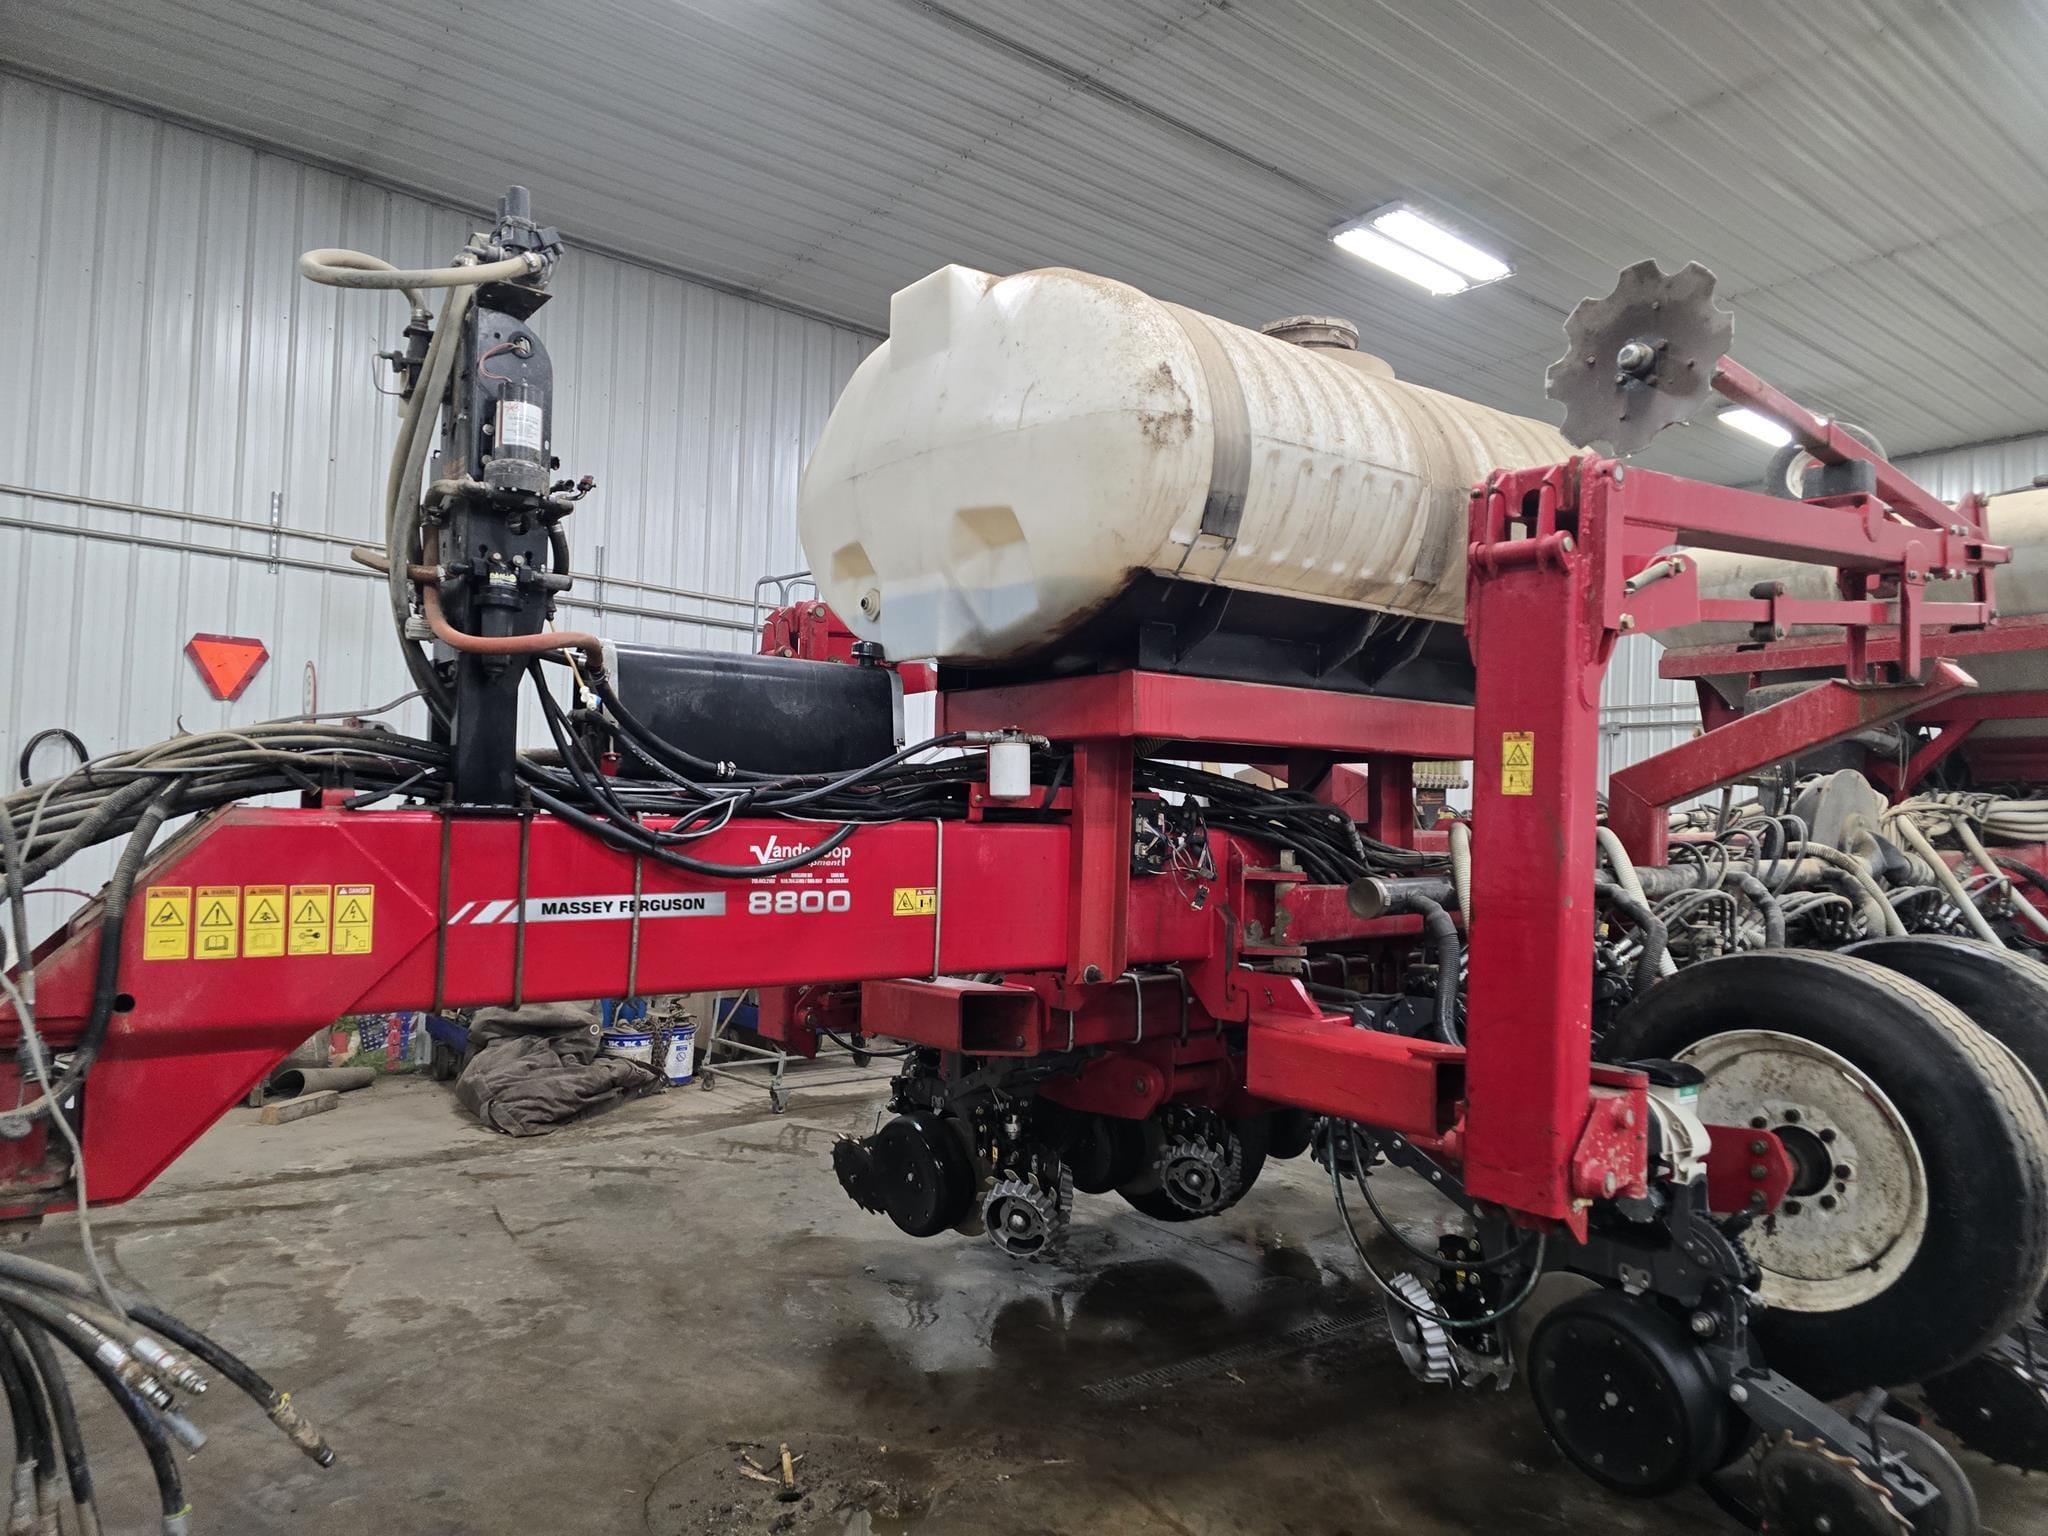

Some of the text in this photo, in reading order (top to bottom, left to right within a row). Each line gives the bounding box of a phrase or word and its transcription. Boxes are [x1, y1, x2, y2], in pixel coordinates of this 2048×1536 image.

[750, 835, 851, 867] Vandop
[541, 898, 705, 915] MASSEY FERGUSON
[748, 890, 851, 915] 8800
